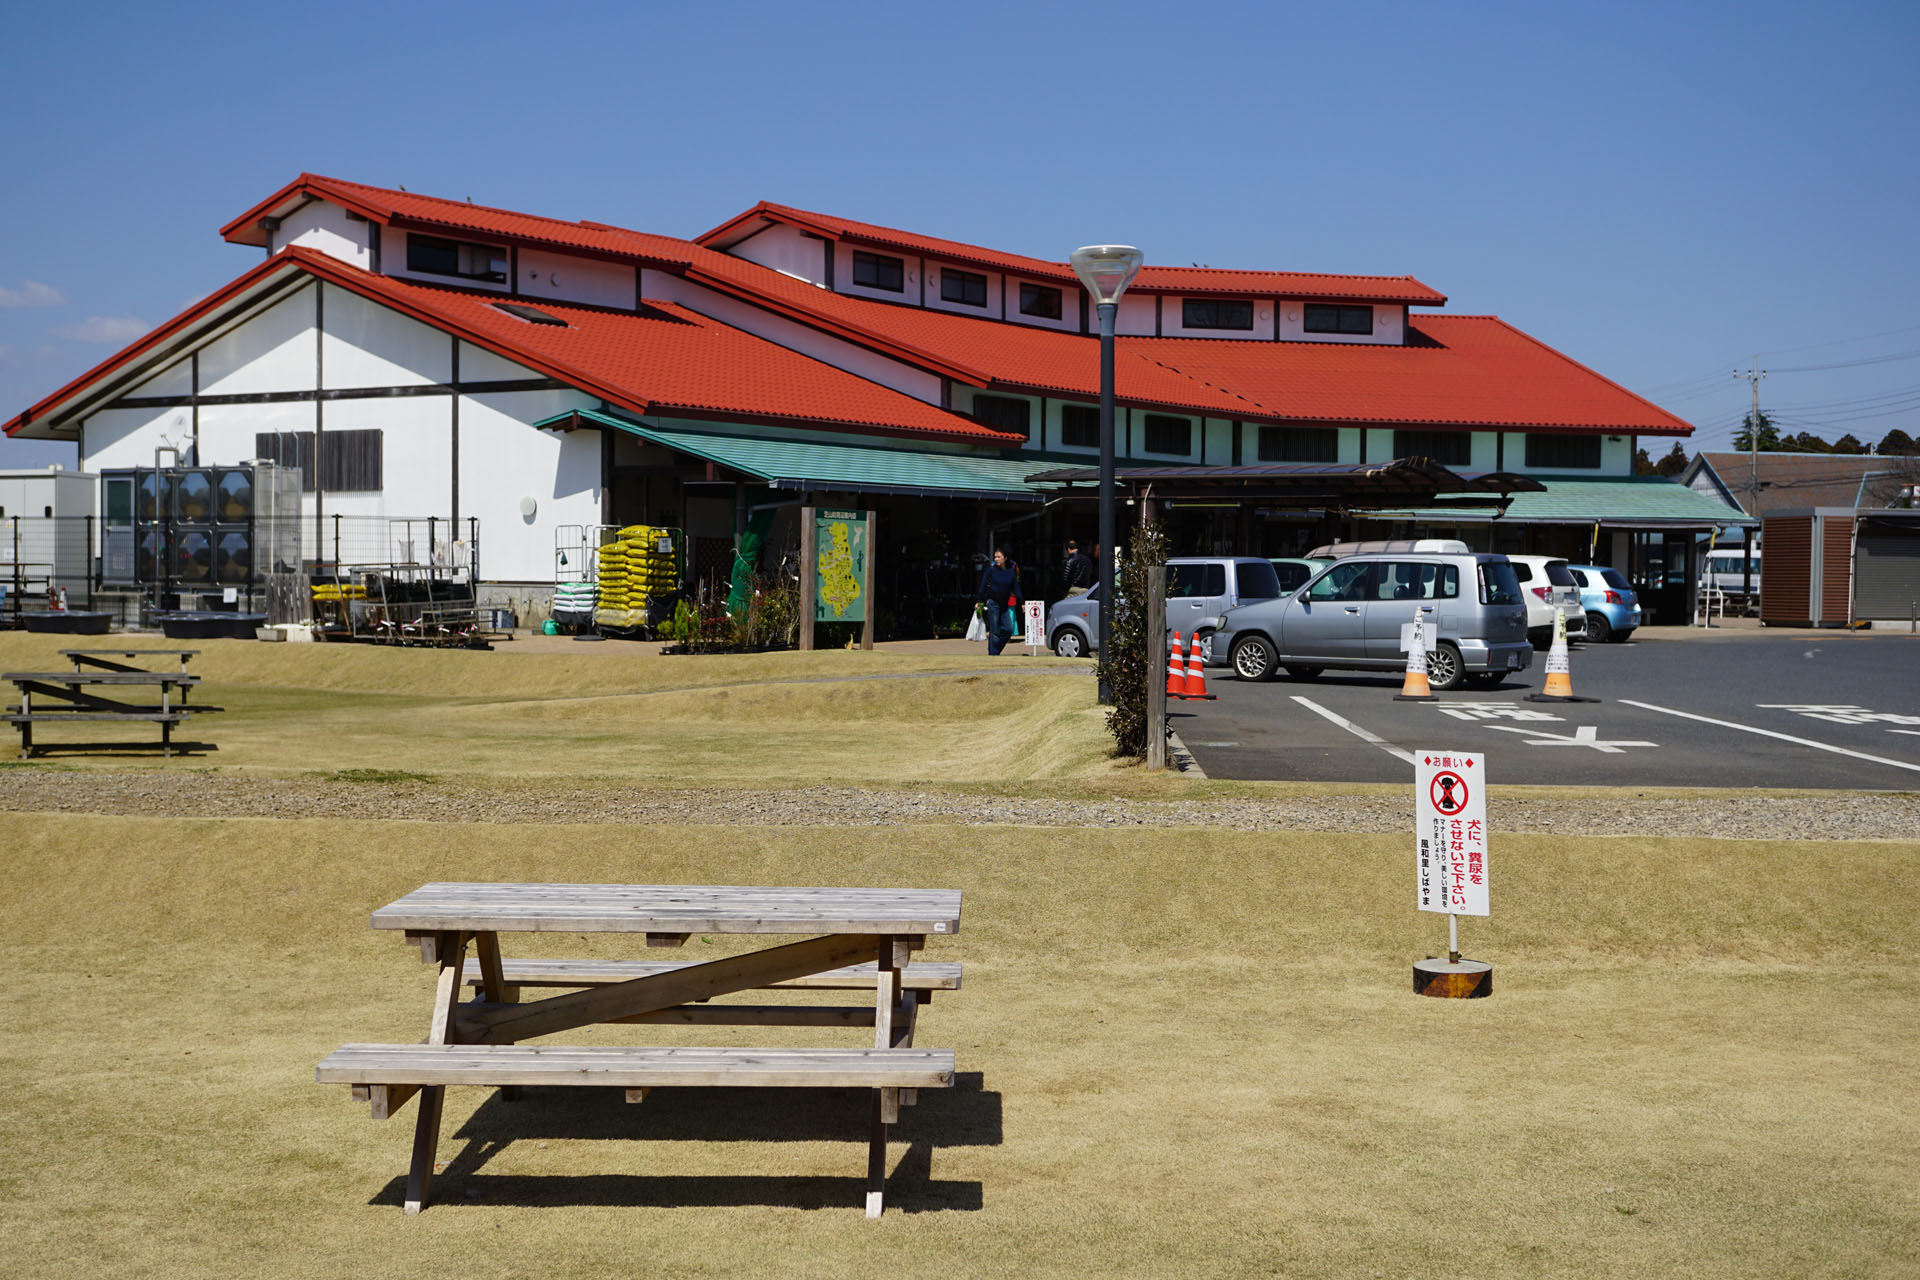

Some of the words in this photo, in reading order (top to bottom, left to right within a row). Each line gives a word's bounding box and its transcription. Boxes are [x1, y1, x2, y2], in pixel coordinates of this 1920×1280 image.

[1432, 756, 1463, 768] お願い
[1450, 819, 1466, 911] させないで下さい。
